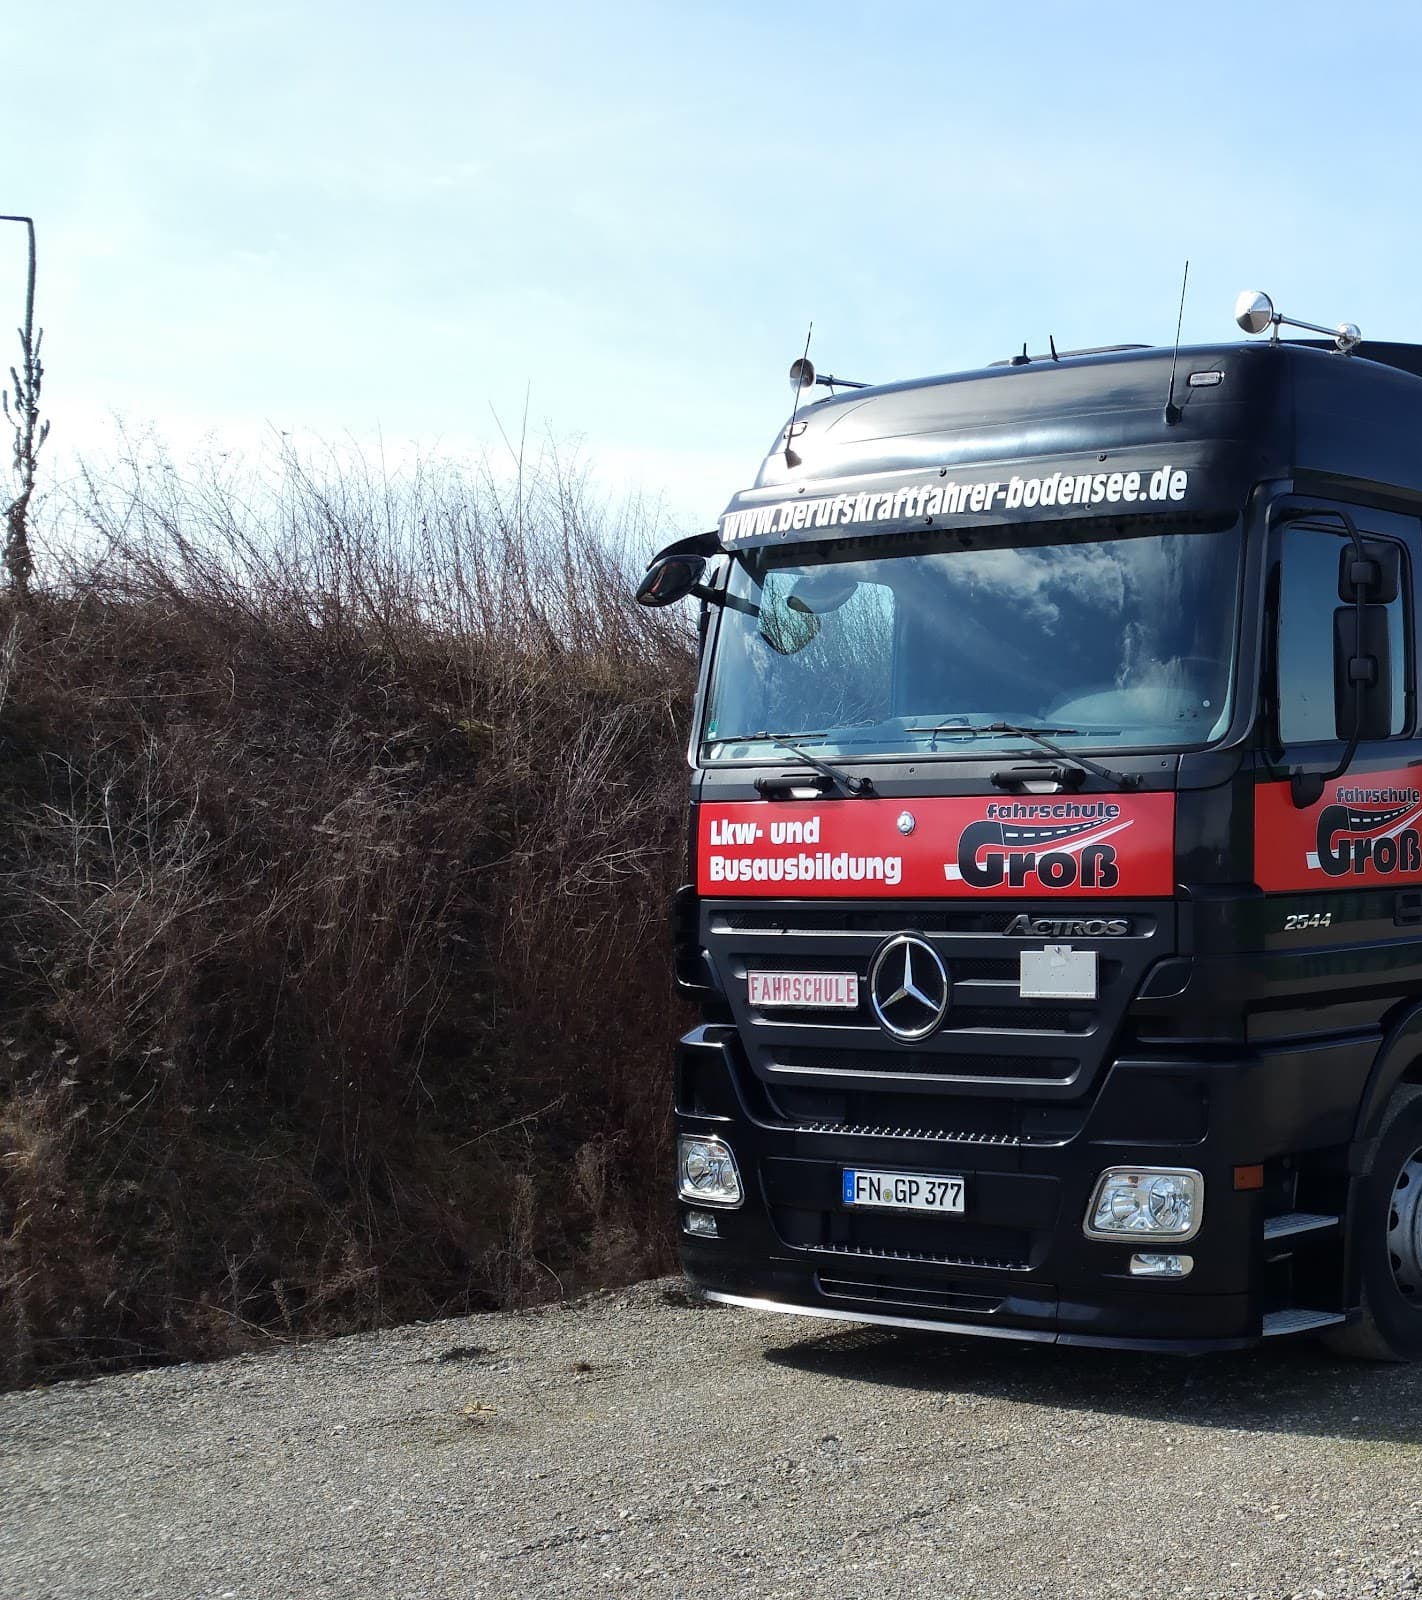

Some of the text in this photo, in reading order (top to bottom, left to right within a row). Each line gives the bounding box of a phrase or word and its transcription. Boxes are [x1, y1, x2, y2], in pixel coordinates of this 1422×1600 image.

[722, 465, 1188, 542] www.berufskraftfahrer-bodensee.de
[1336, 787, 1420, 803] fahrschule
[987, 802, 1120, 819] fahrschule
[710, 816, 820, 845] Lkw- und
[1316, 804, 1422, 877] Groß
[709, 852, 902, 886] Busausbildung
[957, 820, 1120, 889] Groß
[1283, 912, 1333, 931] 2544
[750, 974, 857, 1003] FAHRSCHULE
[856, 1176, 881, 1201] FN
[894, 1179, 920, 1204] GP
[925, 1180, 962, 1207] 377
